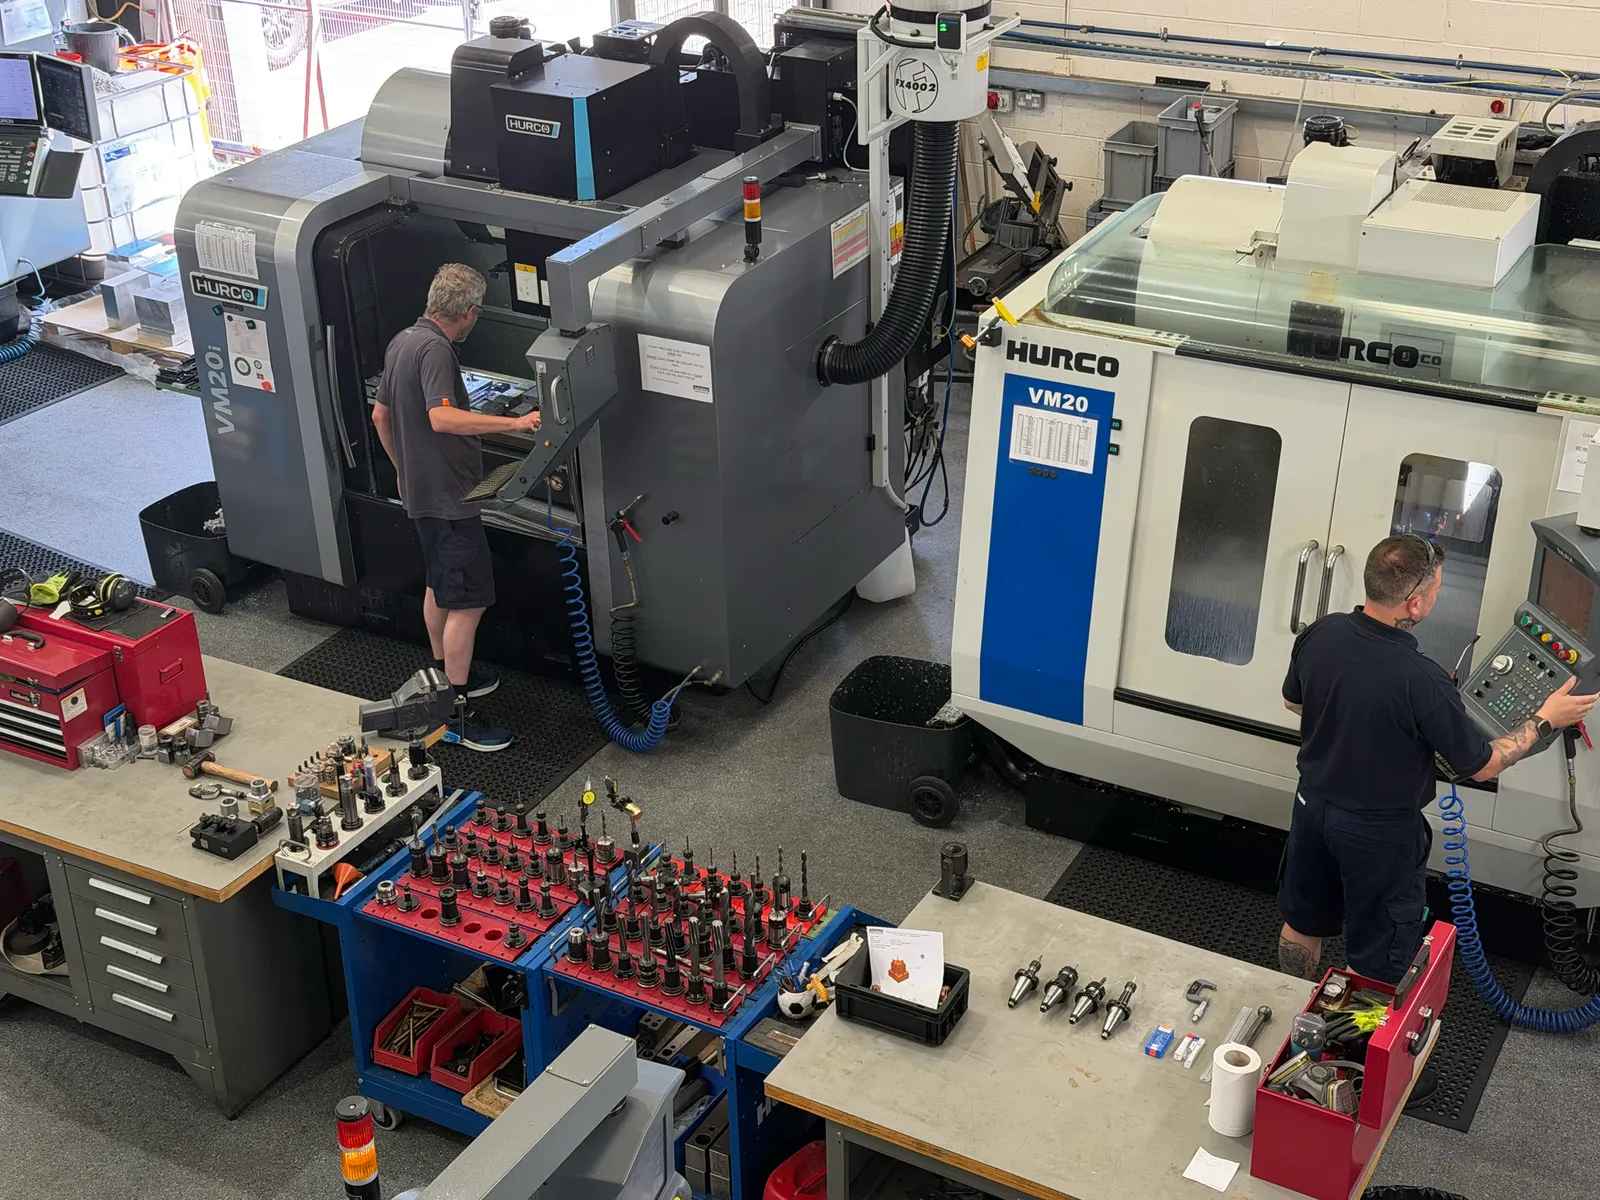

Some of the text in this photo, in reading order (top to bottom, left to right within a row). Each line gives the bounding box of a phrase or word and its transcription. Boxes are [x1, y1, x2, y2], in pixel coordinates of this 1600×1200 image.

[895, 78, 936, 92] FX4002
[509, 118, 551, 134] HURCO
[196, 278, 255, 302] HURCO
[1006, 339, 1120, 378] HURCO
[204, 344, 236, 436] VM20i
[1028, 386, 1089, 413] VM20
